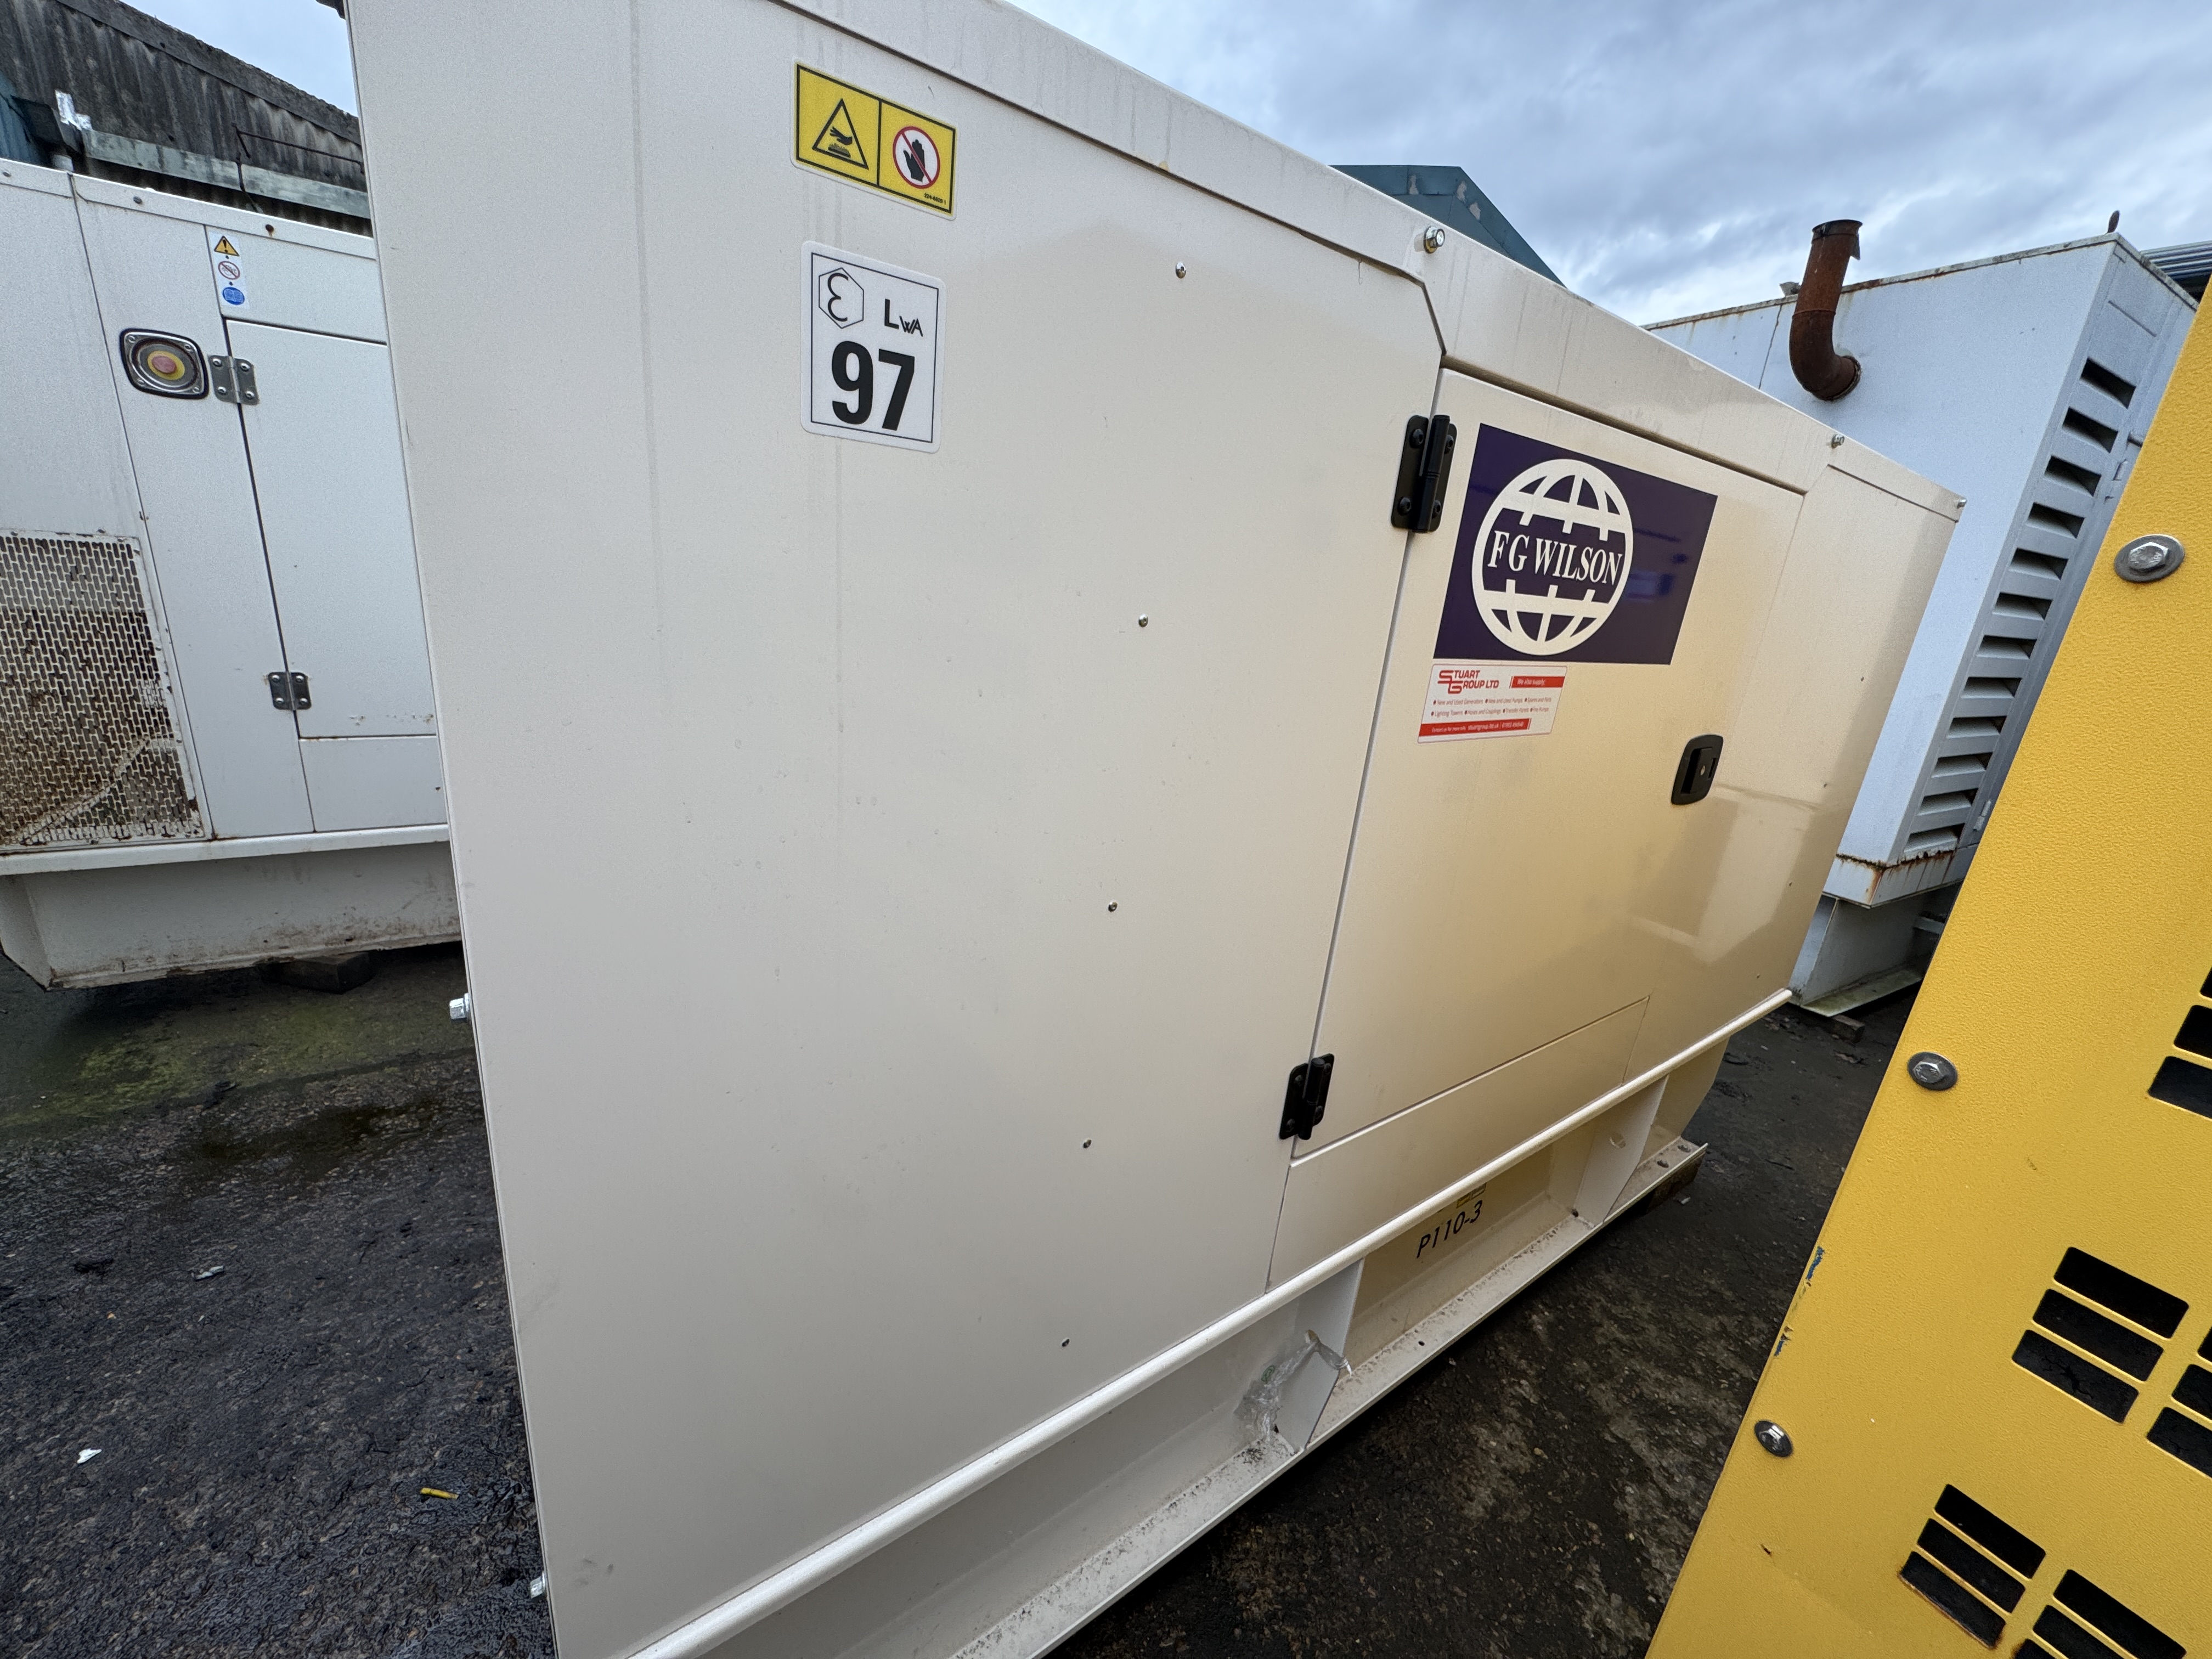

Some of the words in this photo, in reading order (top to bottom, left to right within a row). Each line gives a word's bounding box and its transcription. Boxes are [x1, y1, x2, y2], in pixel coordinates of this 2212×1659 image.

[831, 340, 916, 431] 97
[1487, 529, 1531, 573] FG
[1534, 538, 1623, 586] WILSON
[1437, 680, 1485, 695] GROUP
[1485, 680, 1500, 689] LTD
[1438, 670, 1481, 680] STUART
[1416, 1199, 1483, 1259] P110-3
